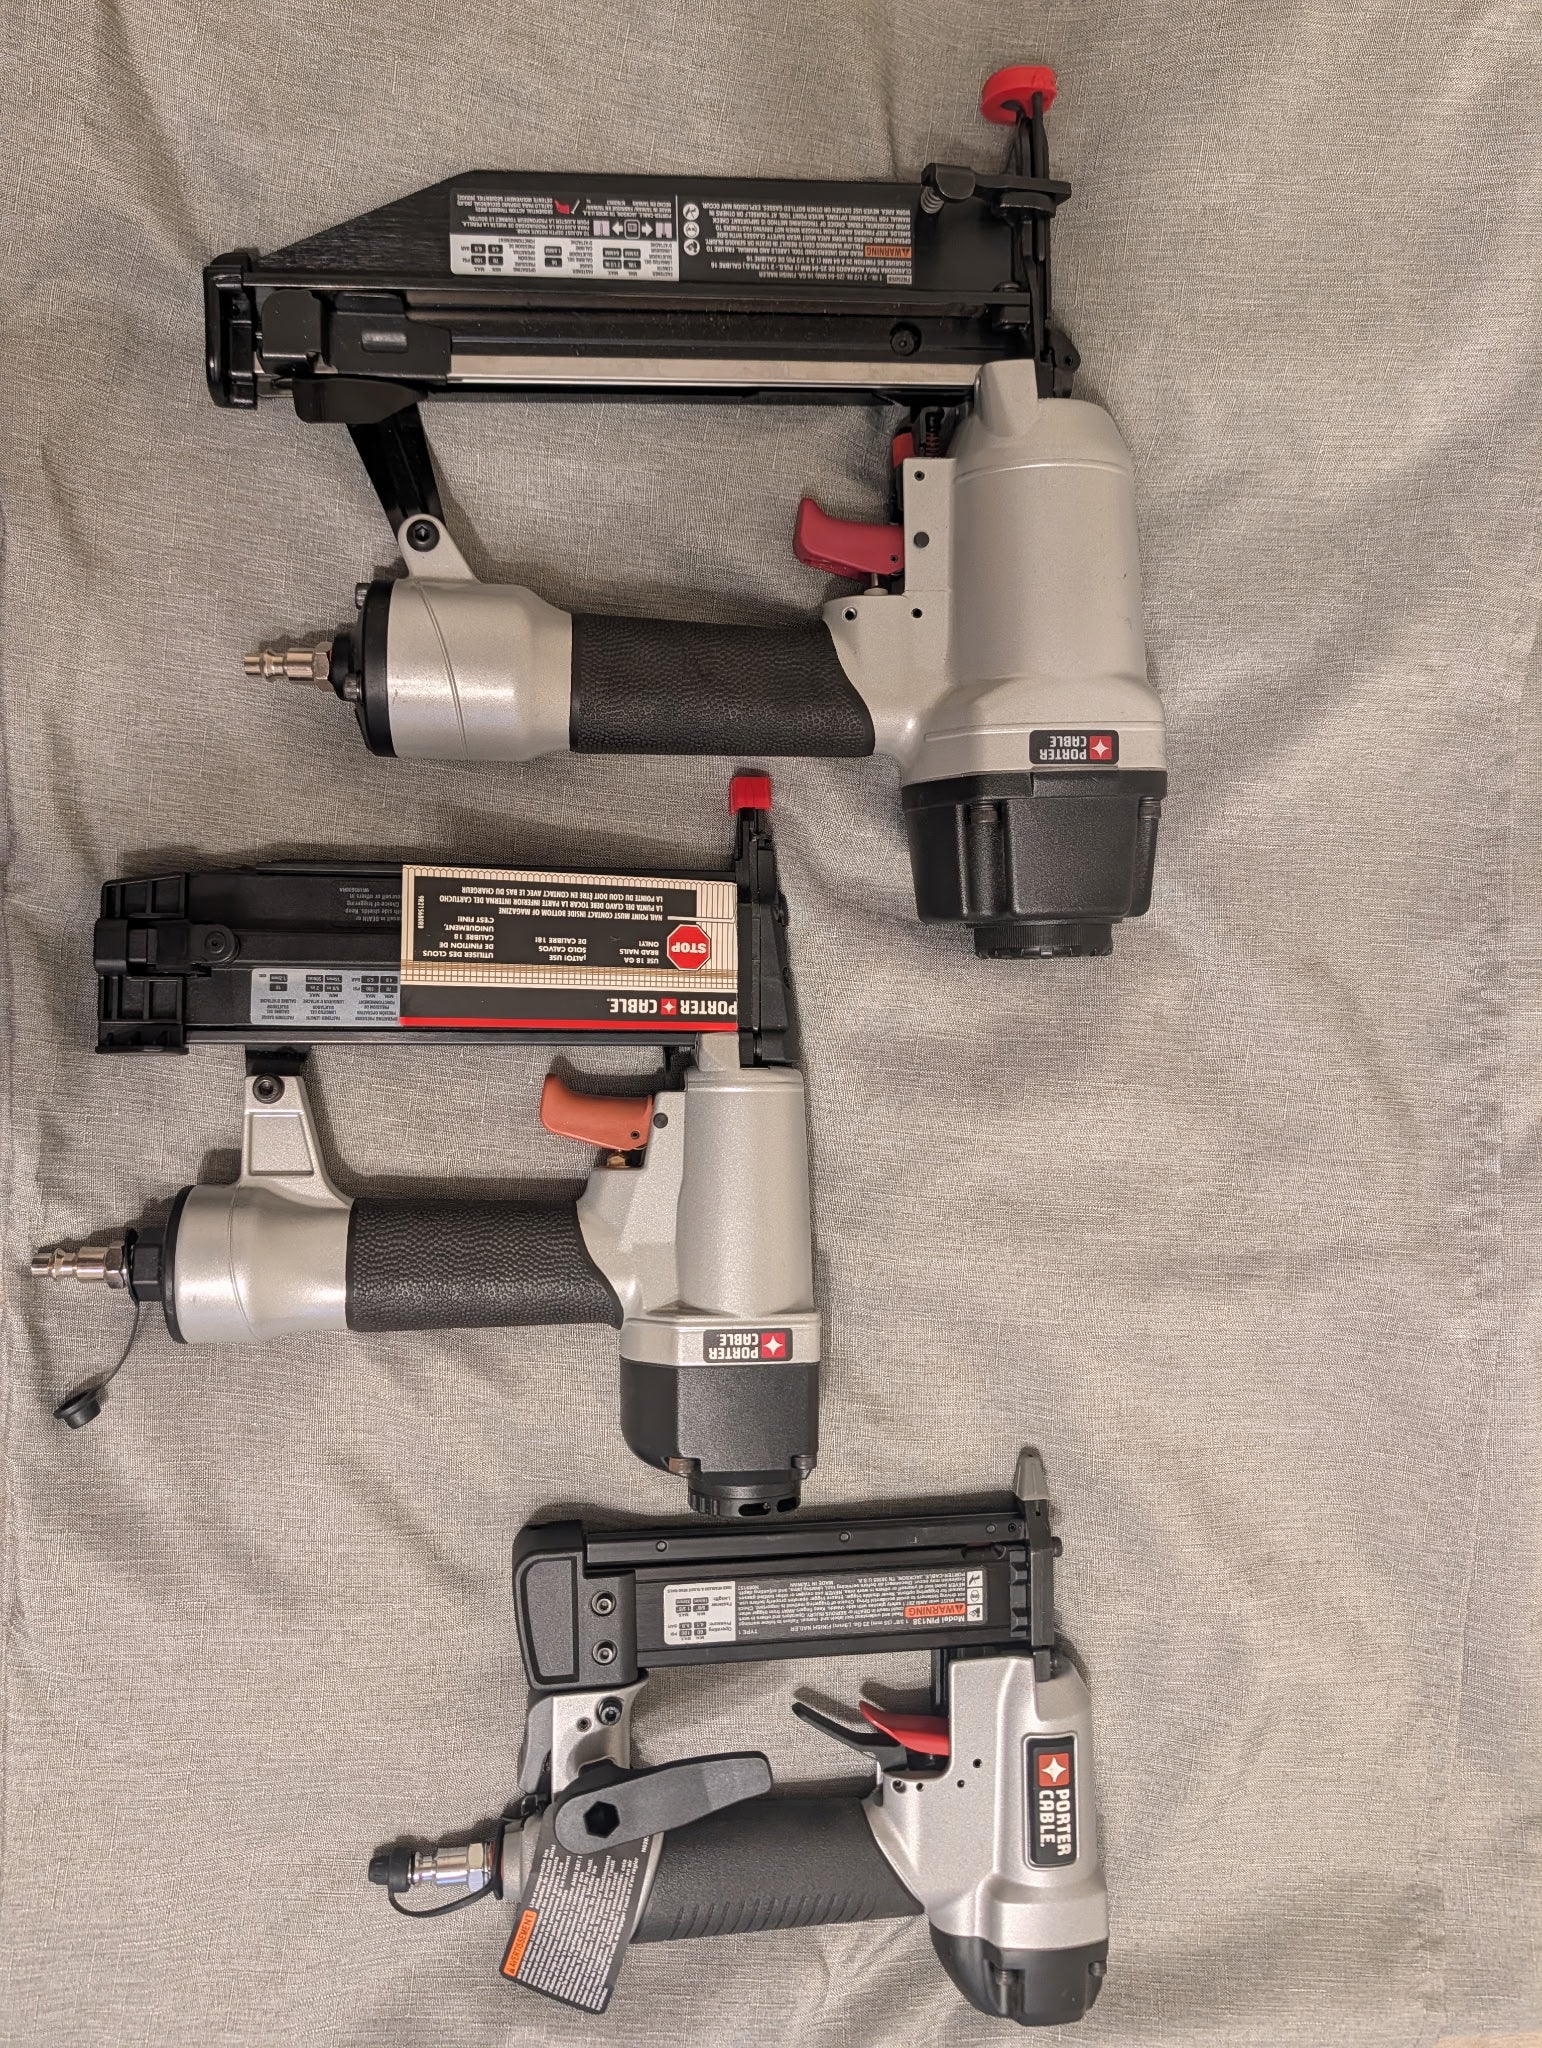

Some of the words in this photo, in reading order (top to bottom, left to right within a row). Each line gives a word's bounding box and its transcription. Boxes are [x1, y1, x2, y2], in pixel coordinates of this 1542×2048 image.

[867, 247, 901, 257] WARNING
[1040, 748, 1086, 761] PORTER
[462, 887, 494, 895] CHARGEUR
[543, 890, 569, 898] CONTACT
[439, 895, 472, 903] CARTUCHO
[485, 897, 511, 905] INTERNA
[635, 894, 655, 902] POINTE
[605, 902, 624, 910] CLAVO
[498, 907, 530, 915] MAGAZINE
[541, 909, 566, 917] BOTTOM
[567, 910, 586, 918] INSIDE
[587, 911, 613, 919] CONTACT
[443, 924, 494, 932] UNIQUEMENT,
[671, 942, 706, 953] STOP
[680, 999, 737, 1015] PORTER
[709, 1347, 758, 1360] PORTER
[909, 1605, 955, 1616] WARNING
[913, 1617, 939, 1625] PIN138
[942, 1615, 965, 1623] Model
[1056, 1789, 1071, 1856] PORTER
[509, 1913, 535, 1968] AVERTISSEMENT
